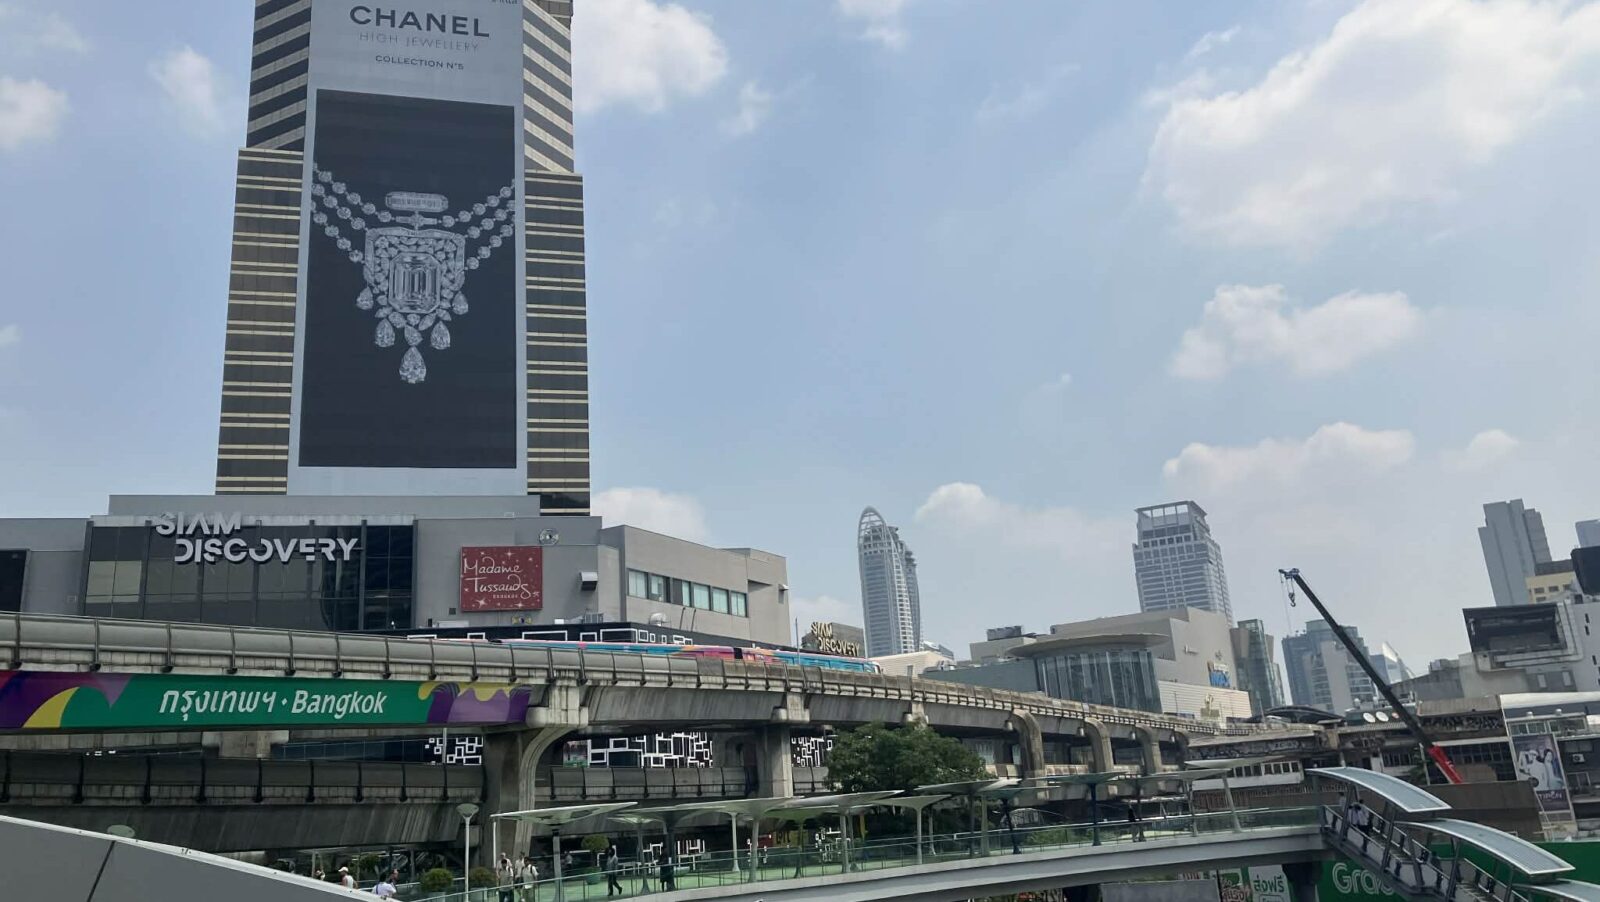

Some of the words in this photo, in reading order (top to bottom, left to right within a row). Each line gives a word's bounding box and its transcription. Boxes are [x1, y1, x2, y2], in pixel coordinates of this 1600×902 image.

[349, 5, 490, 38] CHANEL
[359, 31, 399, 44] HIGH
[406, 36, 480, 52] JEWELLERY
[375, 54, 444, 69] COLLECTION
[154, 511, 242, 536] SIAM
[174, 537, 359, 563] DISCOVERY
[463, 556, 523, 575] Madame
[464, 573, 532, 600] Tussauds
[810, 622, 833, 638] SIAM
[817, 636, 861, 657] DISCOVERY
[158, 690, 277, 722] กรุงเทพฯ
[291, 689, 388, 720] Bangkok
